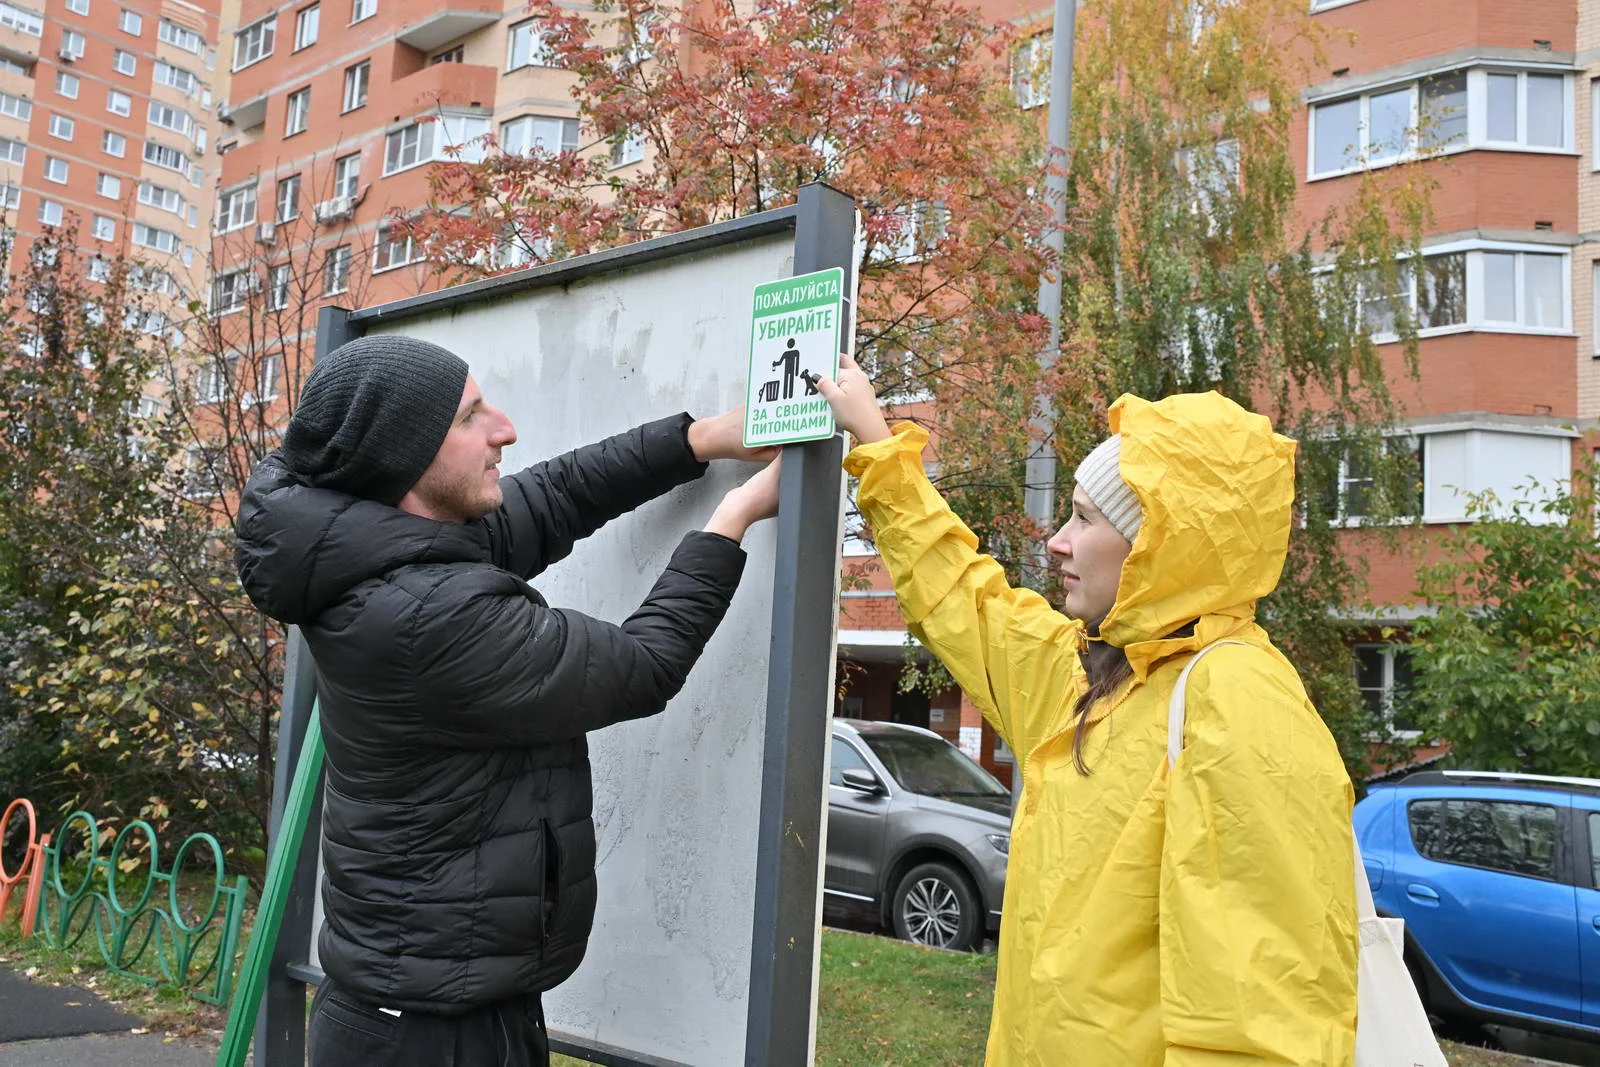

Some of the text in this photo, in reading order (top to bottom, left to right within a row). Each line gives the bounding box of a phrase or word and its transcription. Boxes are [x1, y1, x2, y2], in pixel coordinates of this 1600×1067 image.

[755, 279, 839, 310] ПОЖАЛУЙСТА
[759, 309, 832, 341] УБИРАЙТЕ
[752, 400, 828, 421] ЗА СВОИМИ
[751, 415, 827, 435] ПИТОМЦАМИ
